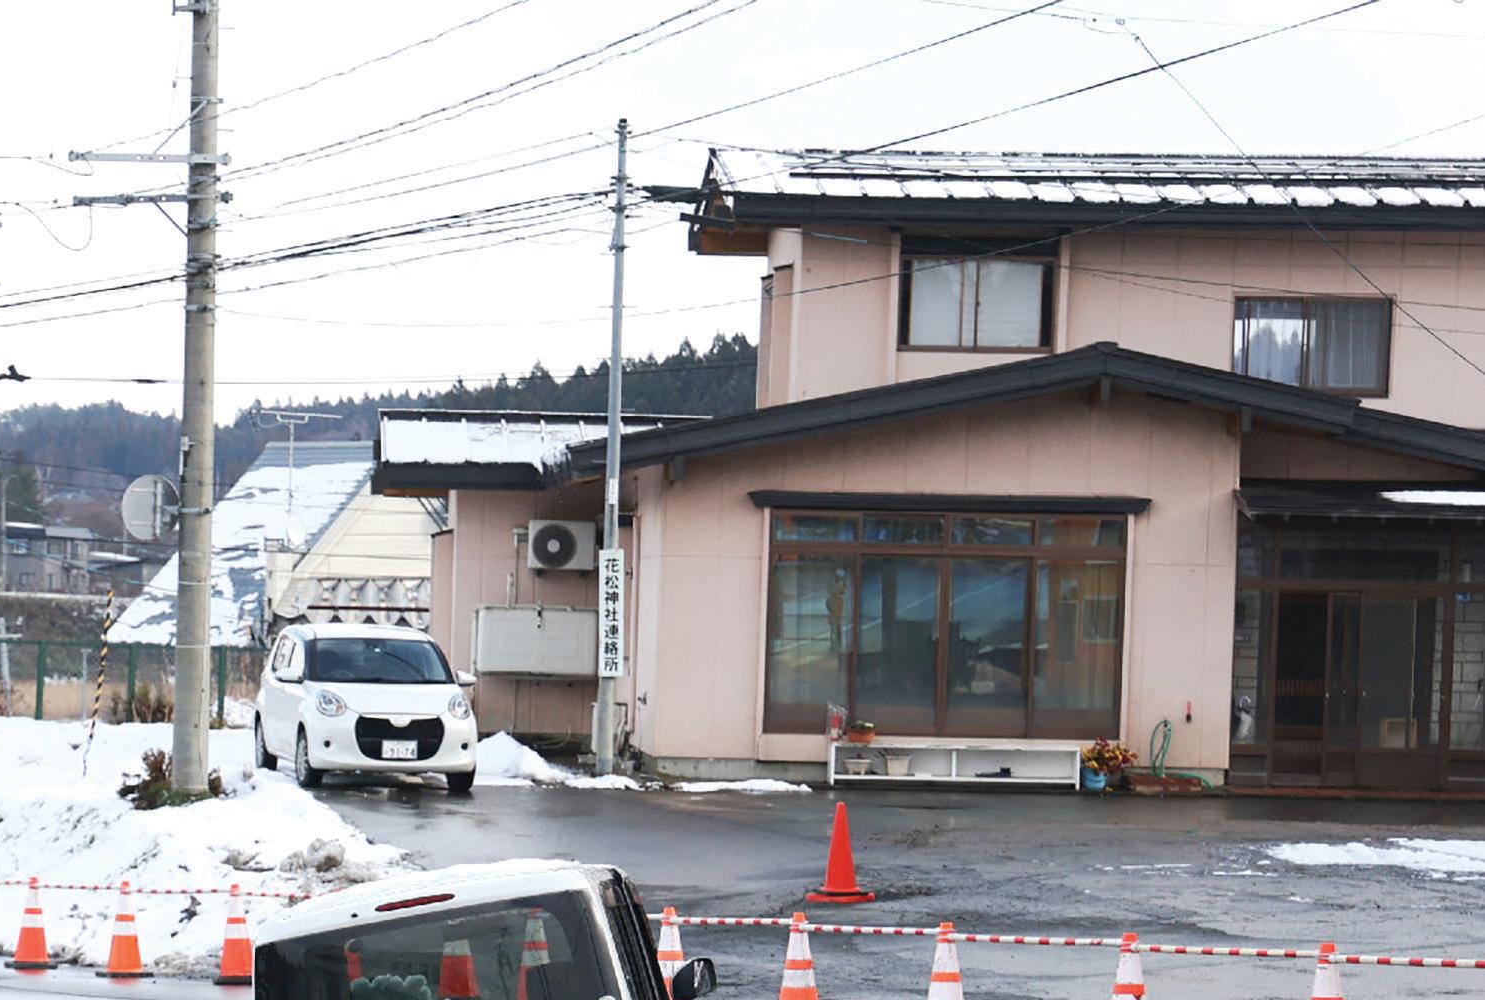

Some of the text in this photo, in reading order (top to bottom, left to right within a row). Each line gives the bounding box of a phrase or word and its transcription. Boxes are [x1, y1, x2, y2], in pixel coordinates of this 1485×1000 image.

[604, 558, 620, 672] 花松神社連絡所
